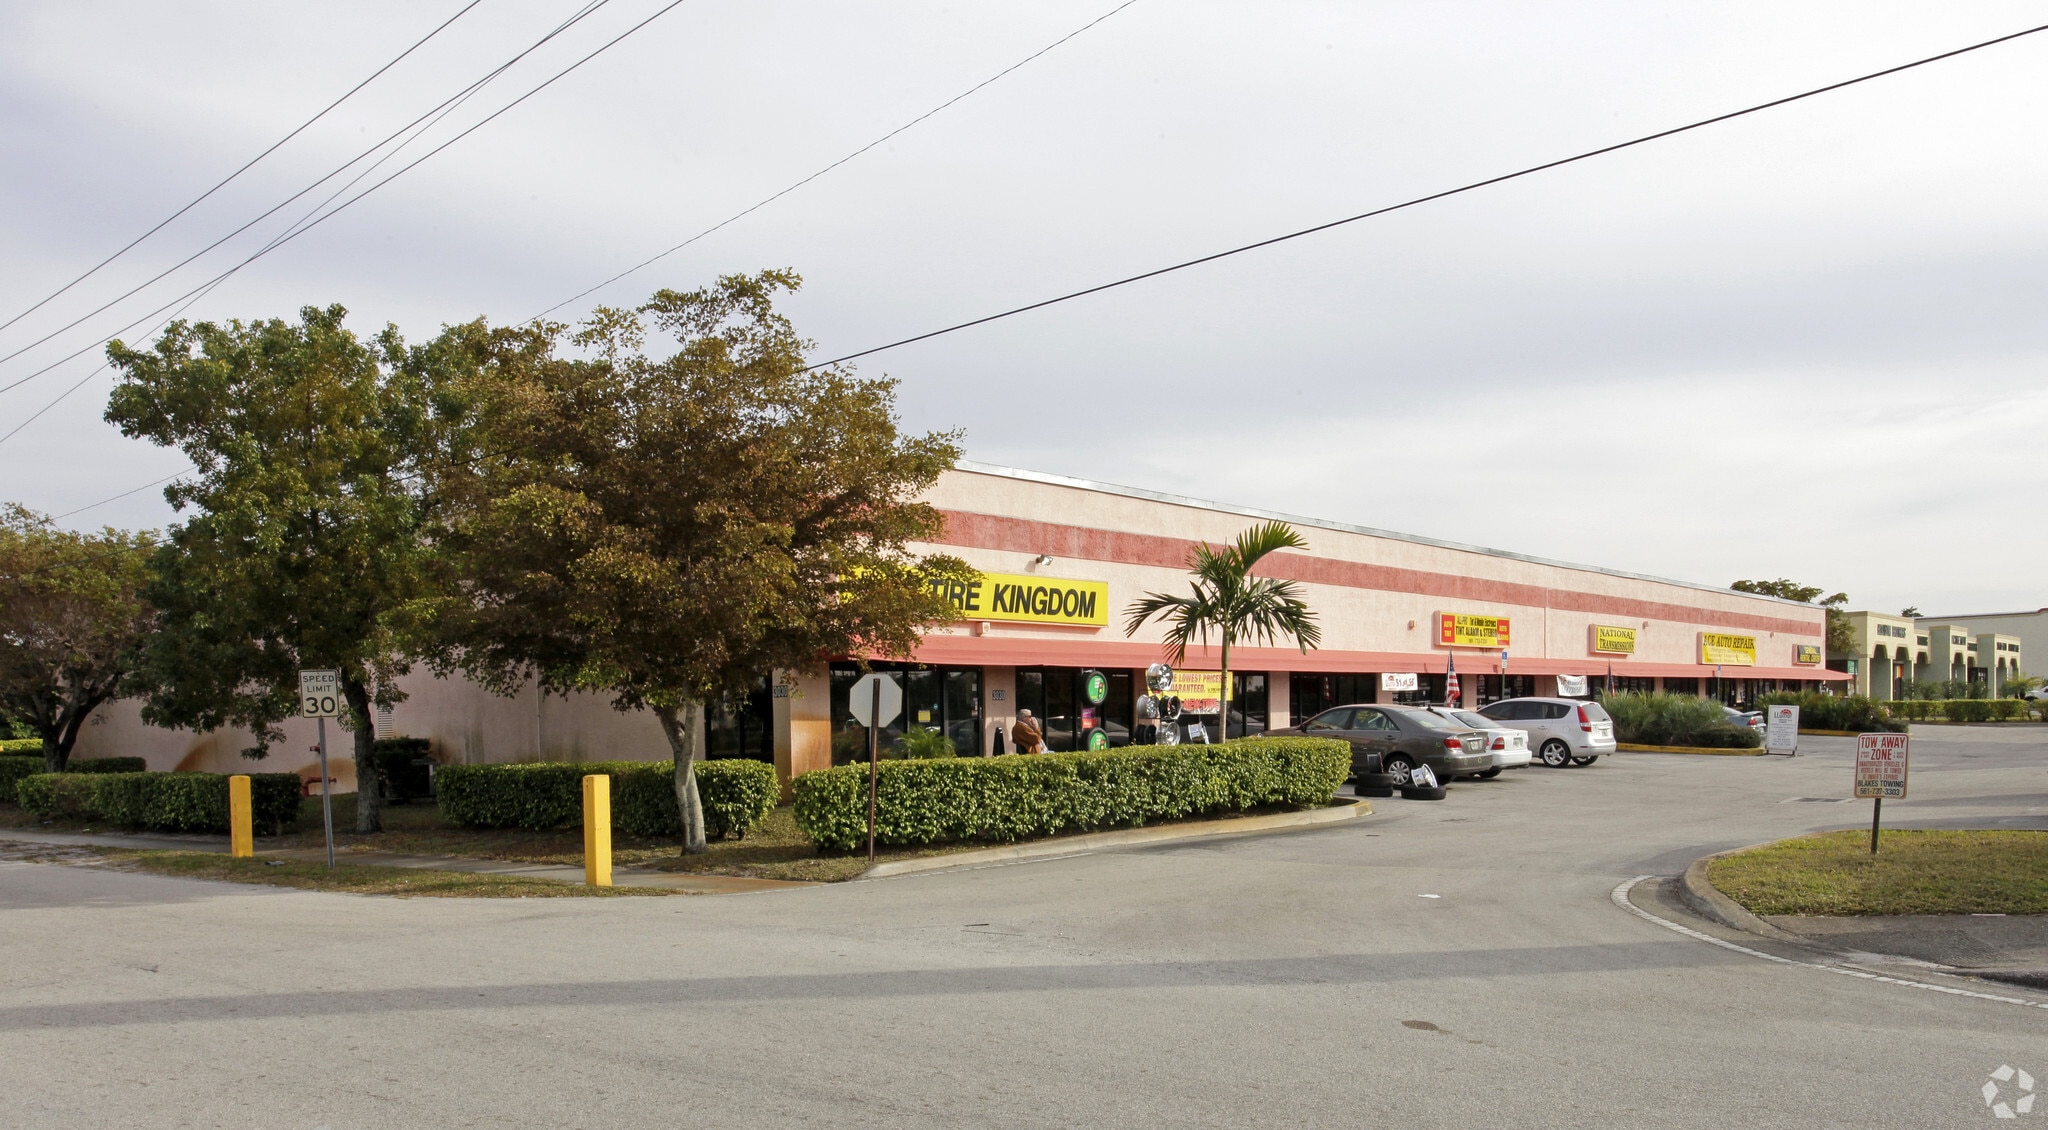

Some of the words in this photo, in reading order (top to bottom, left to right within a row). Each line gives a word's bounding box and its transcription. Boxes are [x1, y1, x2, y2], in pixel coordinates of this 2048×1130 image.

[928, 579, 982, 611] TIRE
[992, 583, 1097, 618] KINGDOM
[1600, 629, 1634, 640] NATIONAL
[1716, 636, 1732, 648] AUTO
[1733, 637, 1755, 649] REPAIR
[303, 675, 335, 683] SPEED
[1179, 674, 1202, 682] LOWEST
[306, 685, 332, 693] LIMIT
[1171, 683, 1206, 693] UARANTEED.
[305, 696, 336, 714] 30
[1861, 737, 1878, 748] TOW
[1881, 737, 1906, 748] AWAY
[1870, 749, 1892, 760] ZONE
[1880, 780, 1904, 788] TOWING
